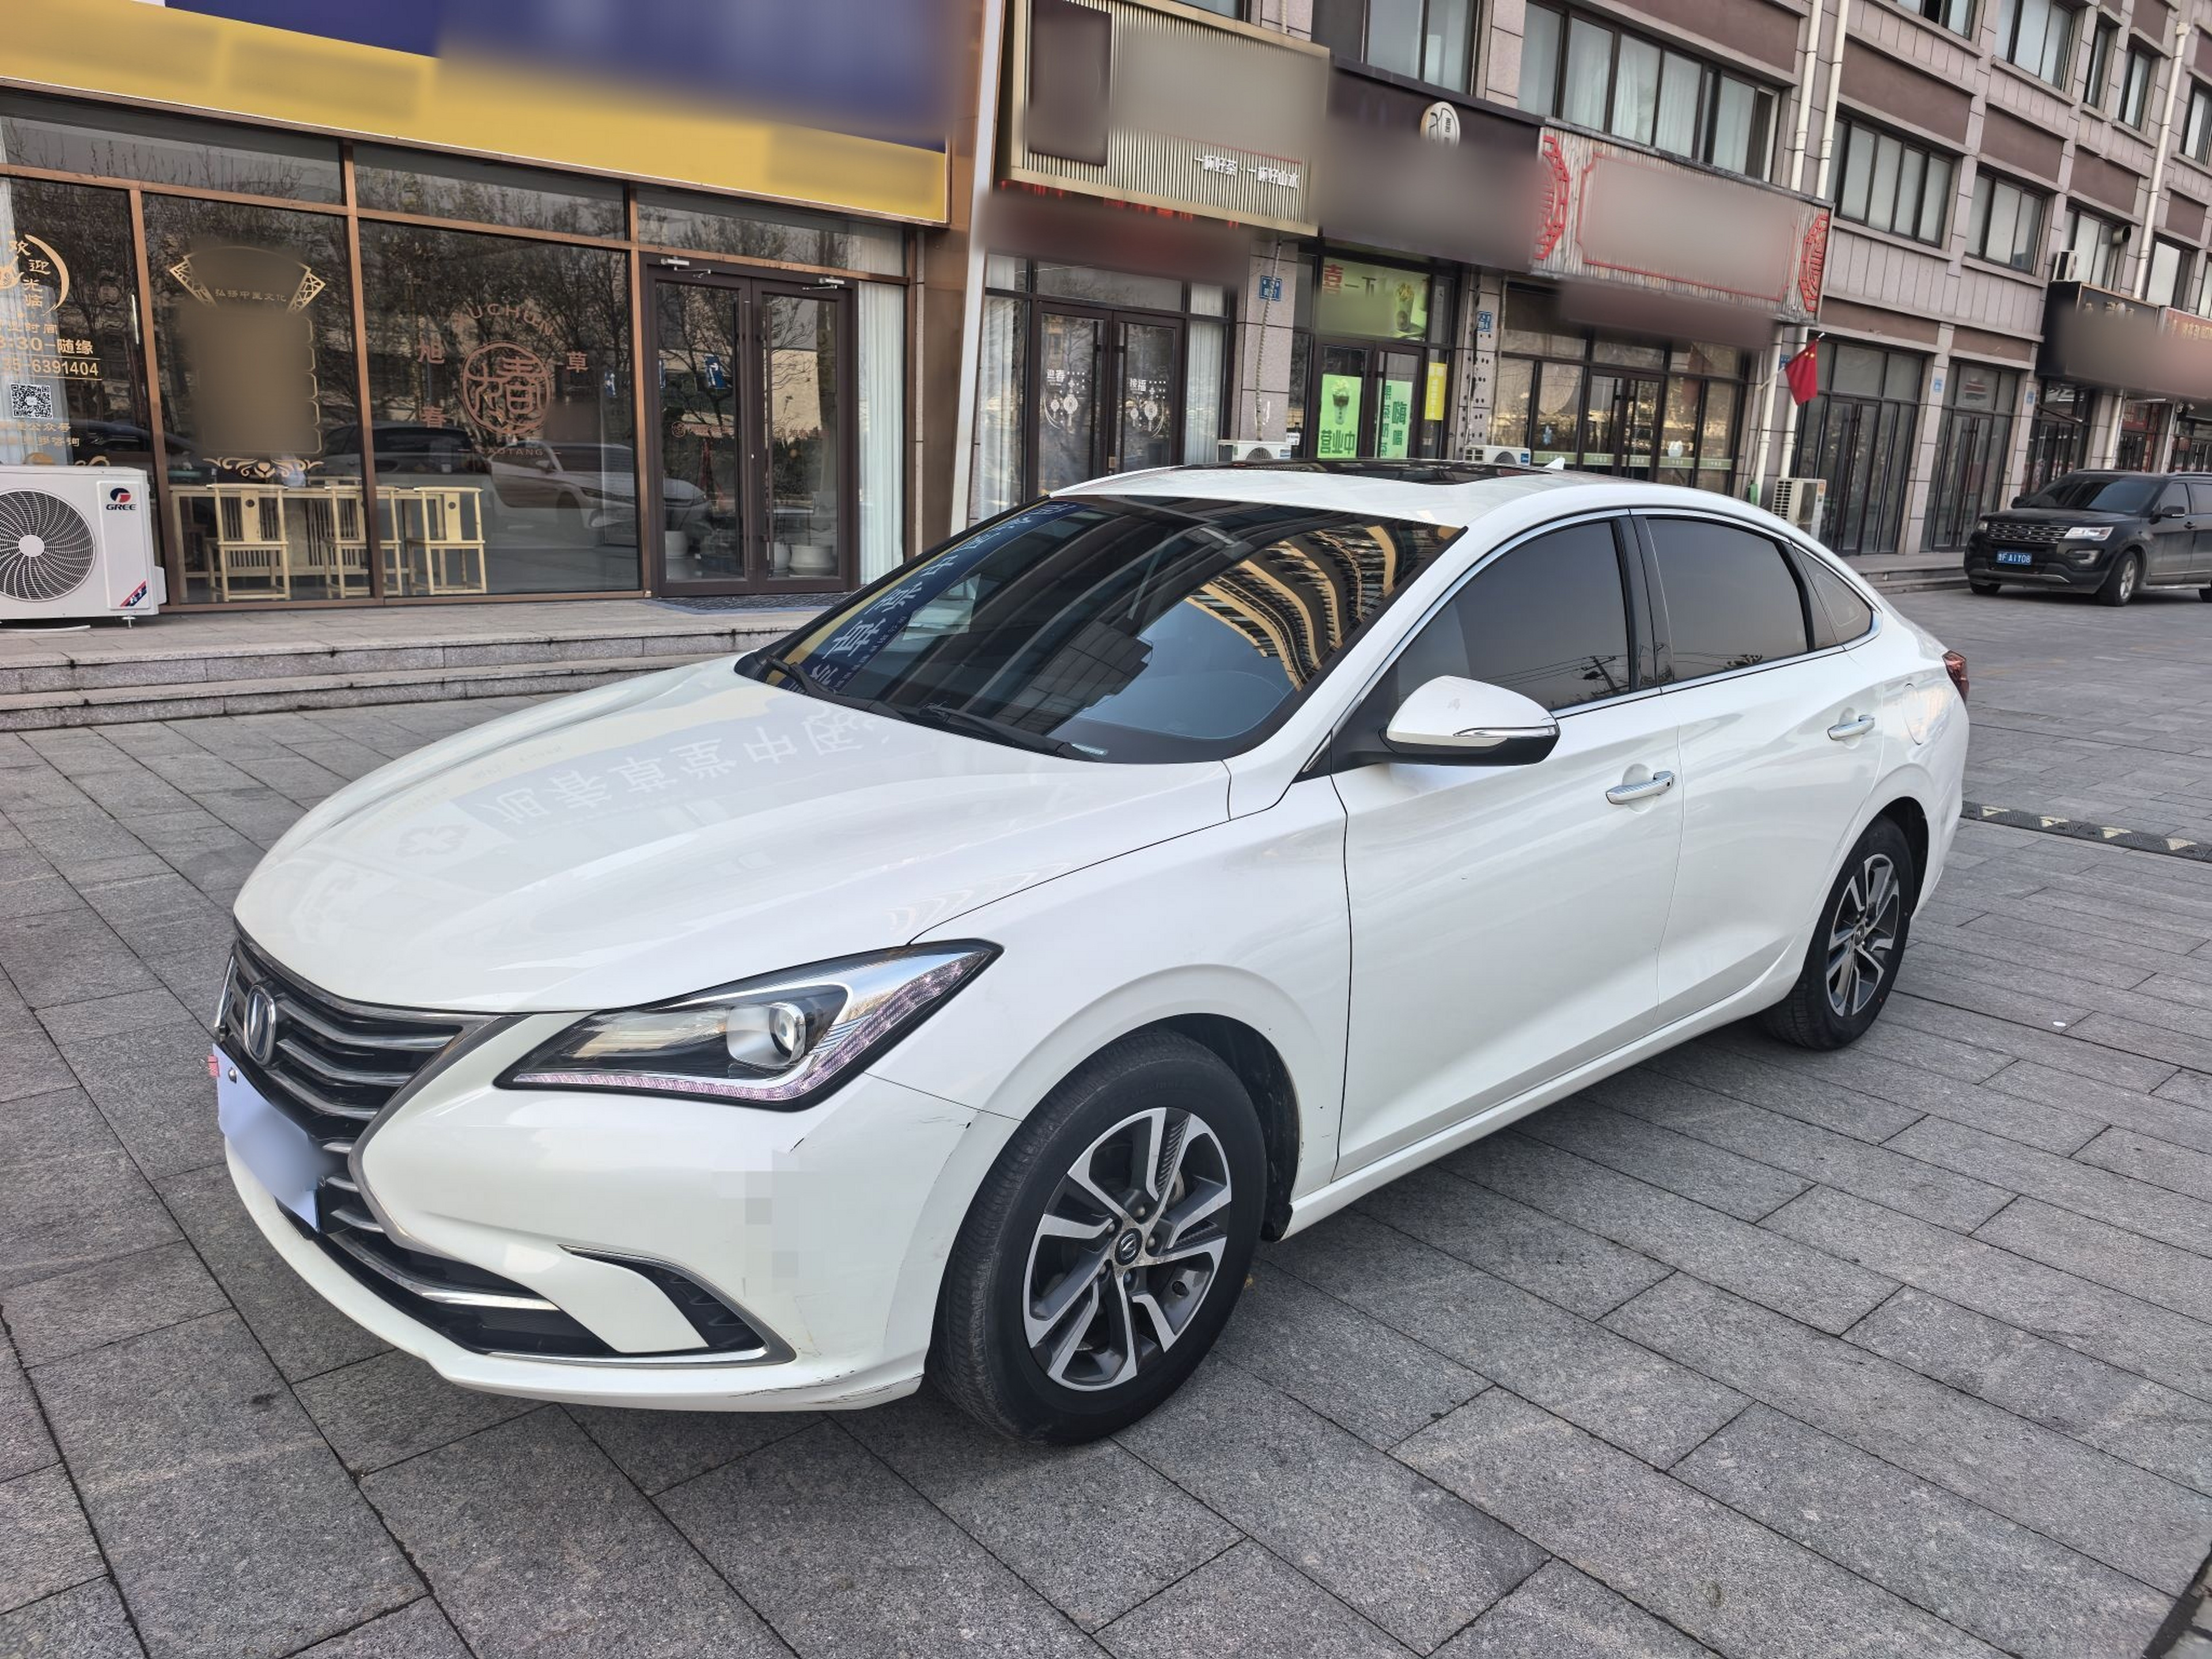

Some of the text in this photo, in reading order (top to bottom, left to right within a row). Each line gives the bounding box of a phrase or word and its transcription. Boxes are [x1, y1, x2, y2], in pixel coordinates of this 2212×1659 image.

[566, 351, 588, 373] 草
[1320, 429, 1355, 454] 营业中
